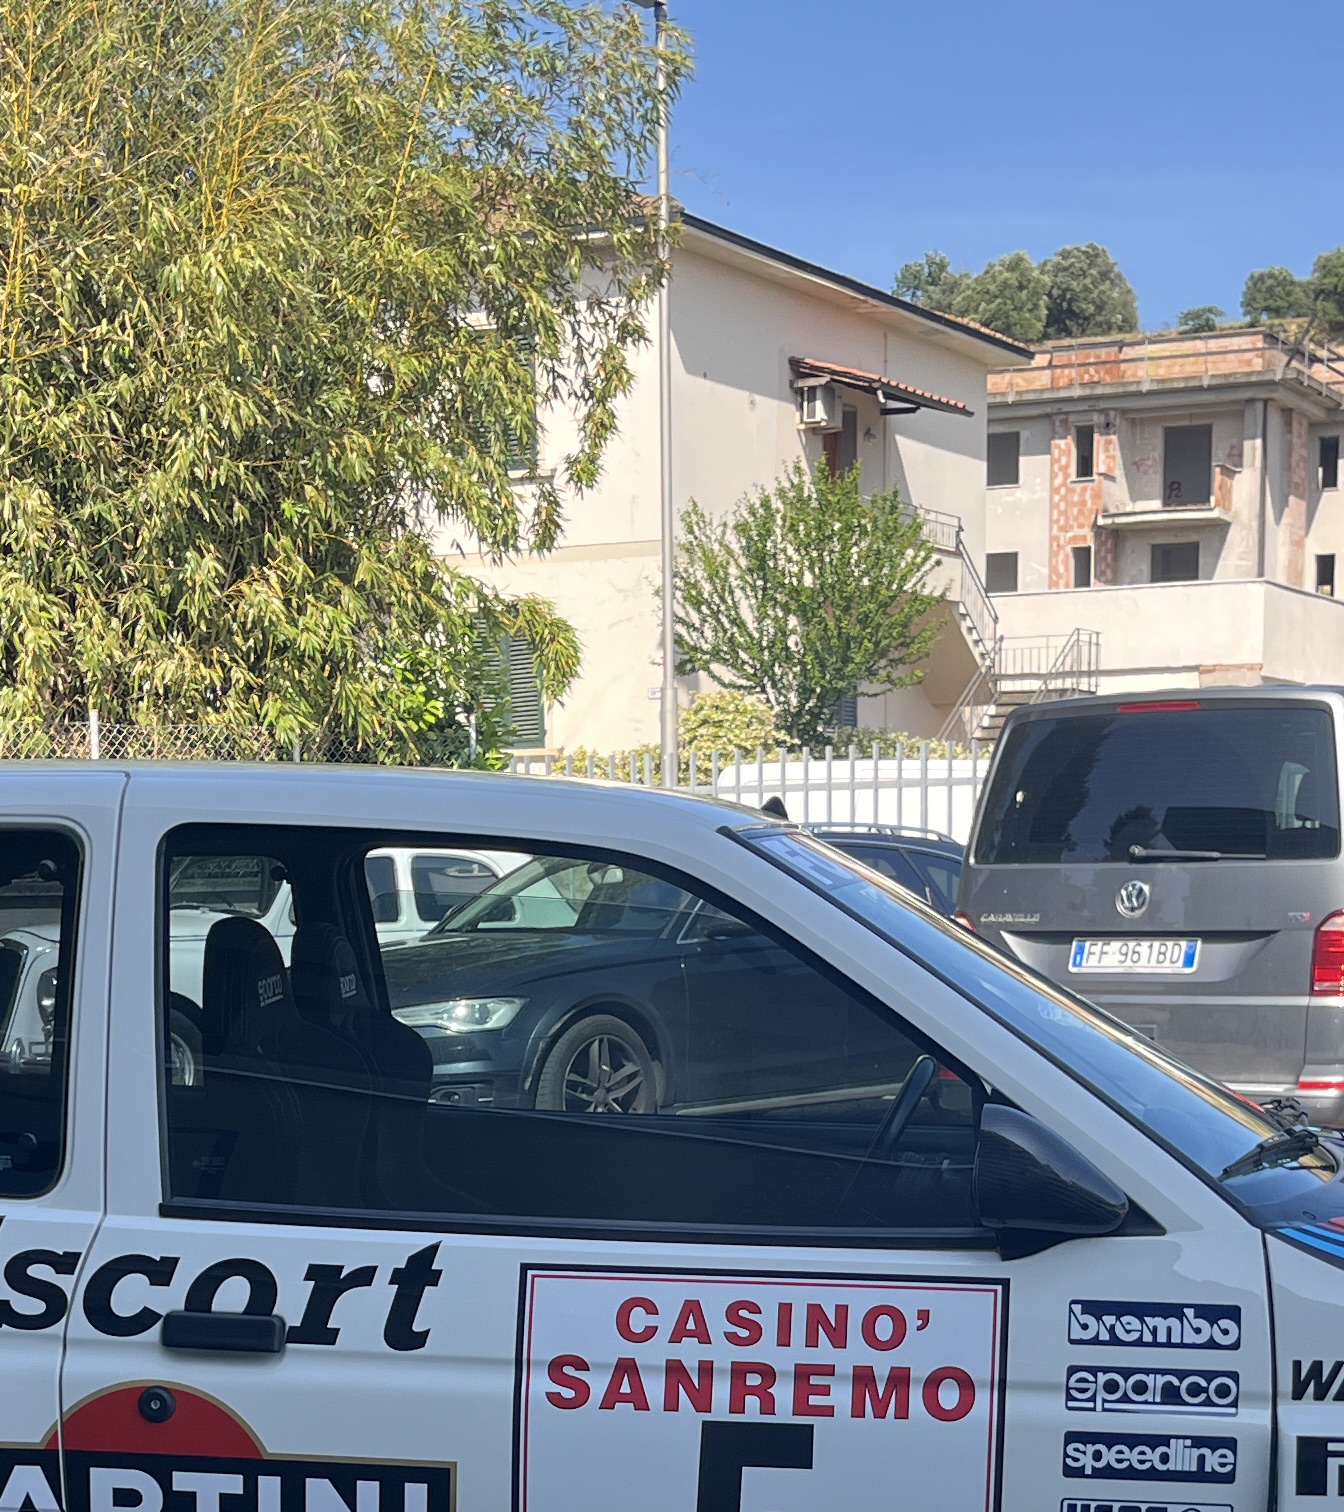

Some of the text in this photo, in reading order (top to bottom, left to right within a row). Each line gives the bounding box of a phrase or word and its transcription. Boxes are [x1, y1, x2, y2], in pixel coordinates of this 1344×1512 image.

[1069, 1303, 1239, 1346] brembo
[544, 1354, 976, 1423] SANREMO
[1067, 1370, 1238, 1412] sparco
[1064, 1438, 1235, 1475] speedline
